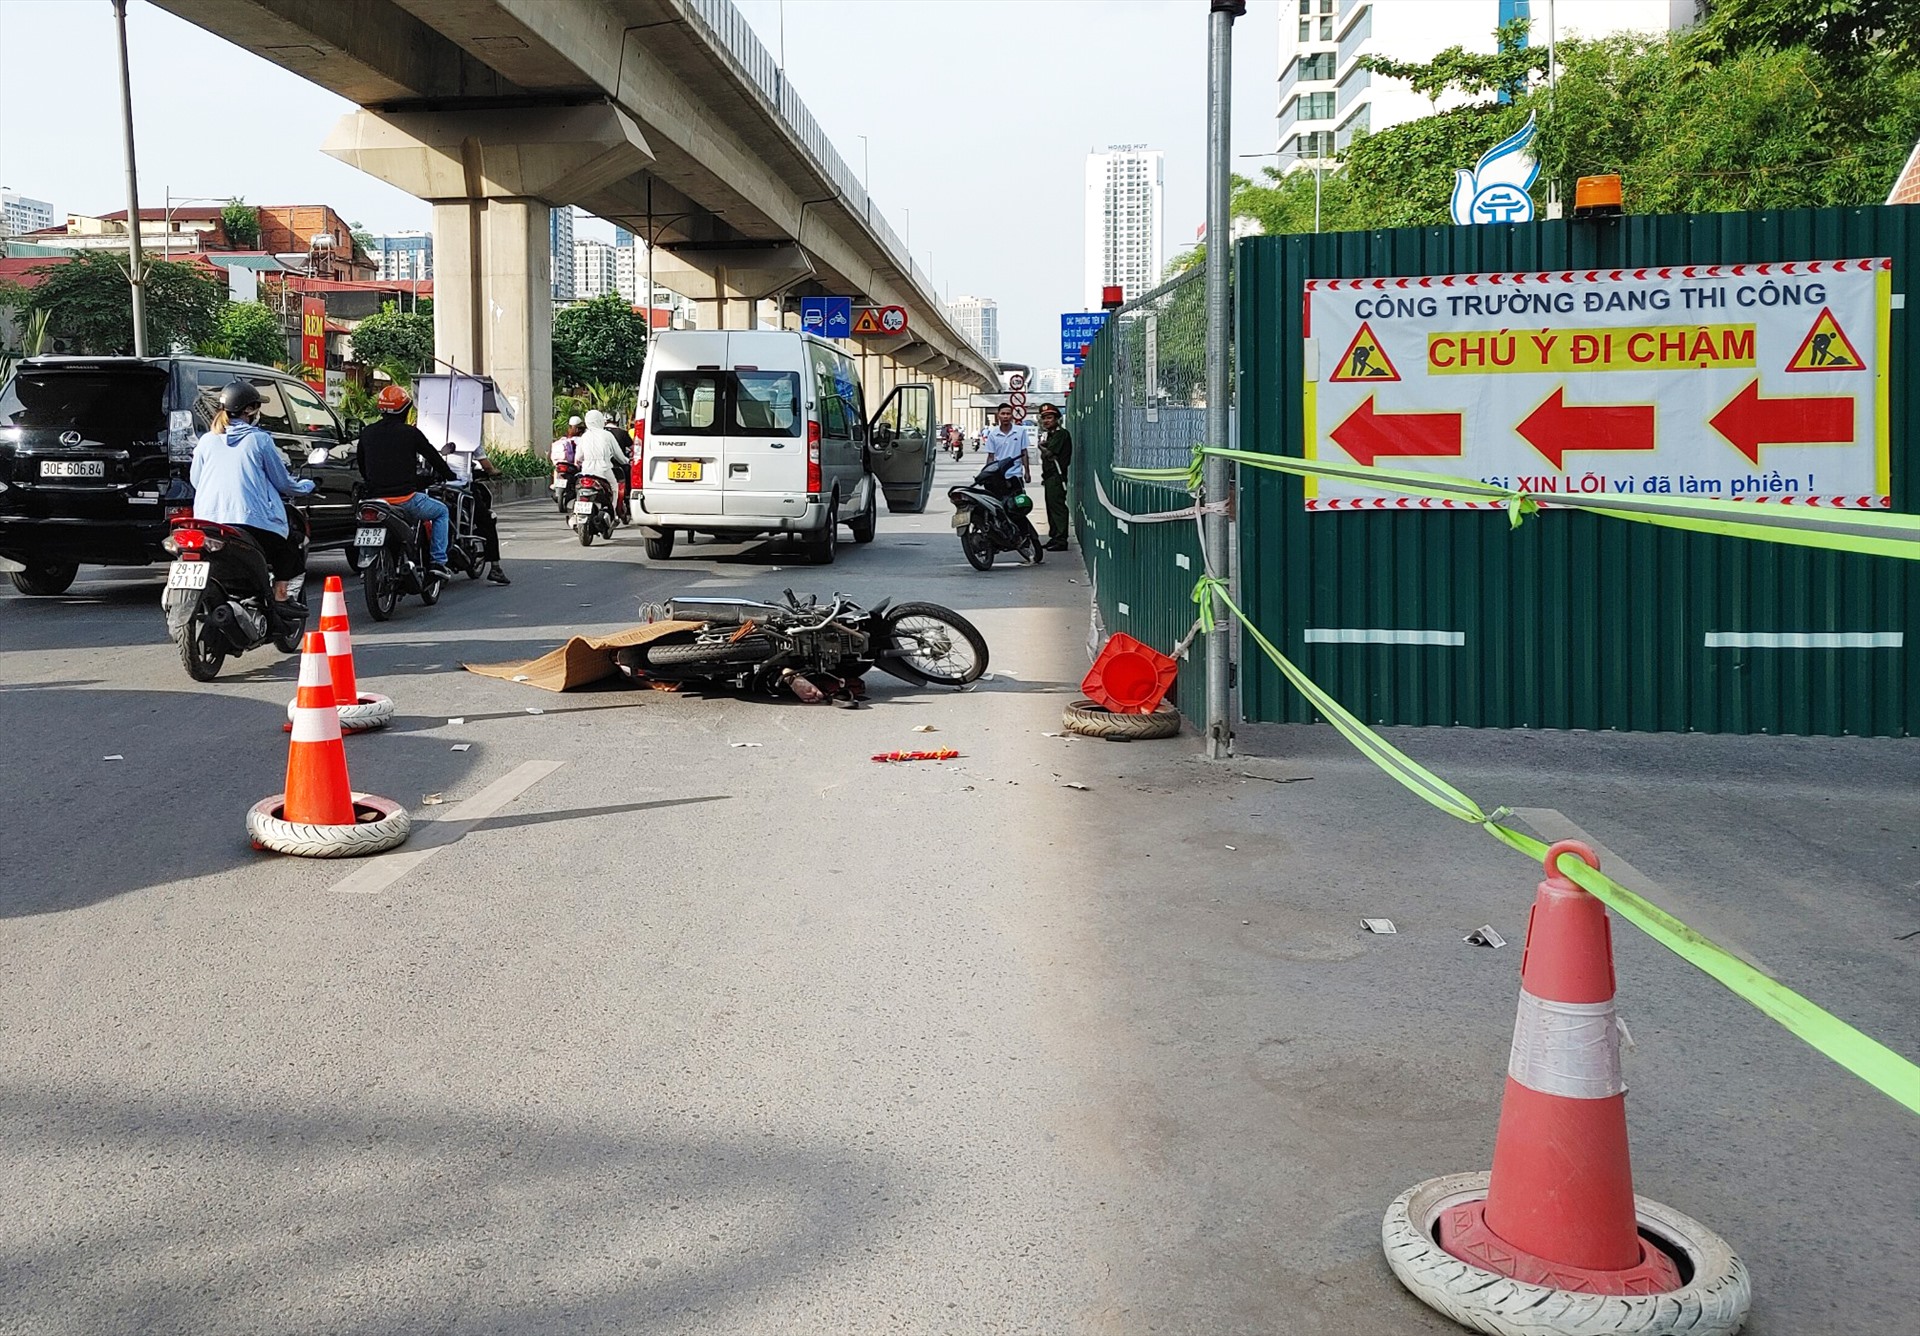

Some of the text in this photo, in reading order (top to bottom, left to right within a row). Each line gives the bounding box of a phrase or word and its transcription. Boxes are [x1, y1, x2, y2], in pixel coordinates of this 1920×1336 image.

[1354, 279, 1826, 319] CÔNG TRƯỜNG ĐANG THI CÔNG
[304, 309, 324, 338] RÈM
[1428, 326, 1755, 369] CHÚ Ý ĐI CHẬM
[1516, 476, 1557, 493] XIN
[1566, 471, 1606, 493] LỖI
[1614, 475, 1635, 494] vì
[1642, 475, 1671, 494] đã
[1679, 475, 1722, 493] làm
[1730, 470, 1799, 496] phiền
[1808, 473, 1814, 492] !
[170, 575, 205, 588] 471.10
